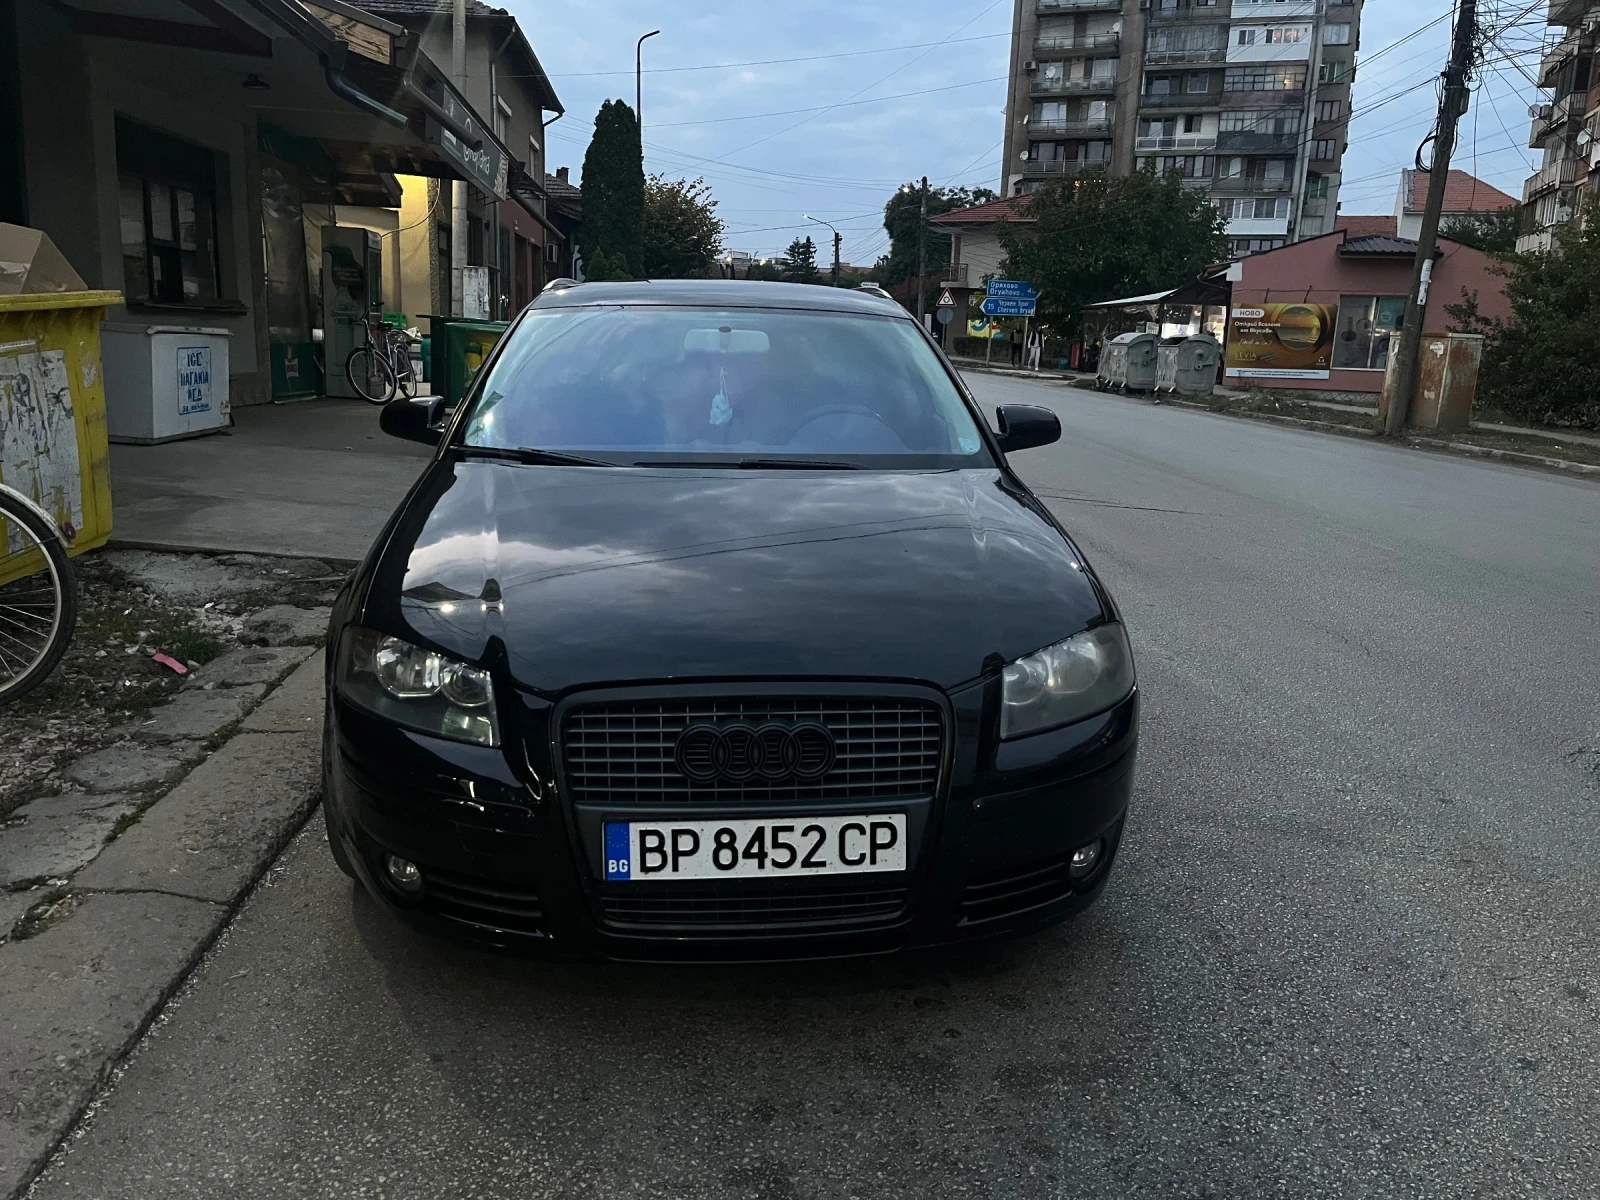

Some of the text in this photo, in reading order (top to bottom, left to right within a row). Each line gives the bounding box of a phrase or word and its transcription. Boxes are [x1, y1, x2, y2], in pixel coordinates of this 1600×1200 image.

[989, 288, 1020, 296] Oryahovo
[990, 281, 1019, 289] Оряхово
[187, 352, 202, 367] ICE
[639, 821, 898, 873] BP 8452 CP
[608, 859, 629, 873] BG
